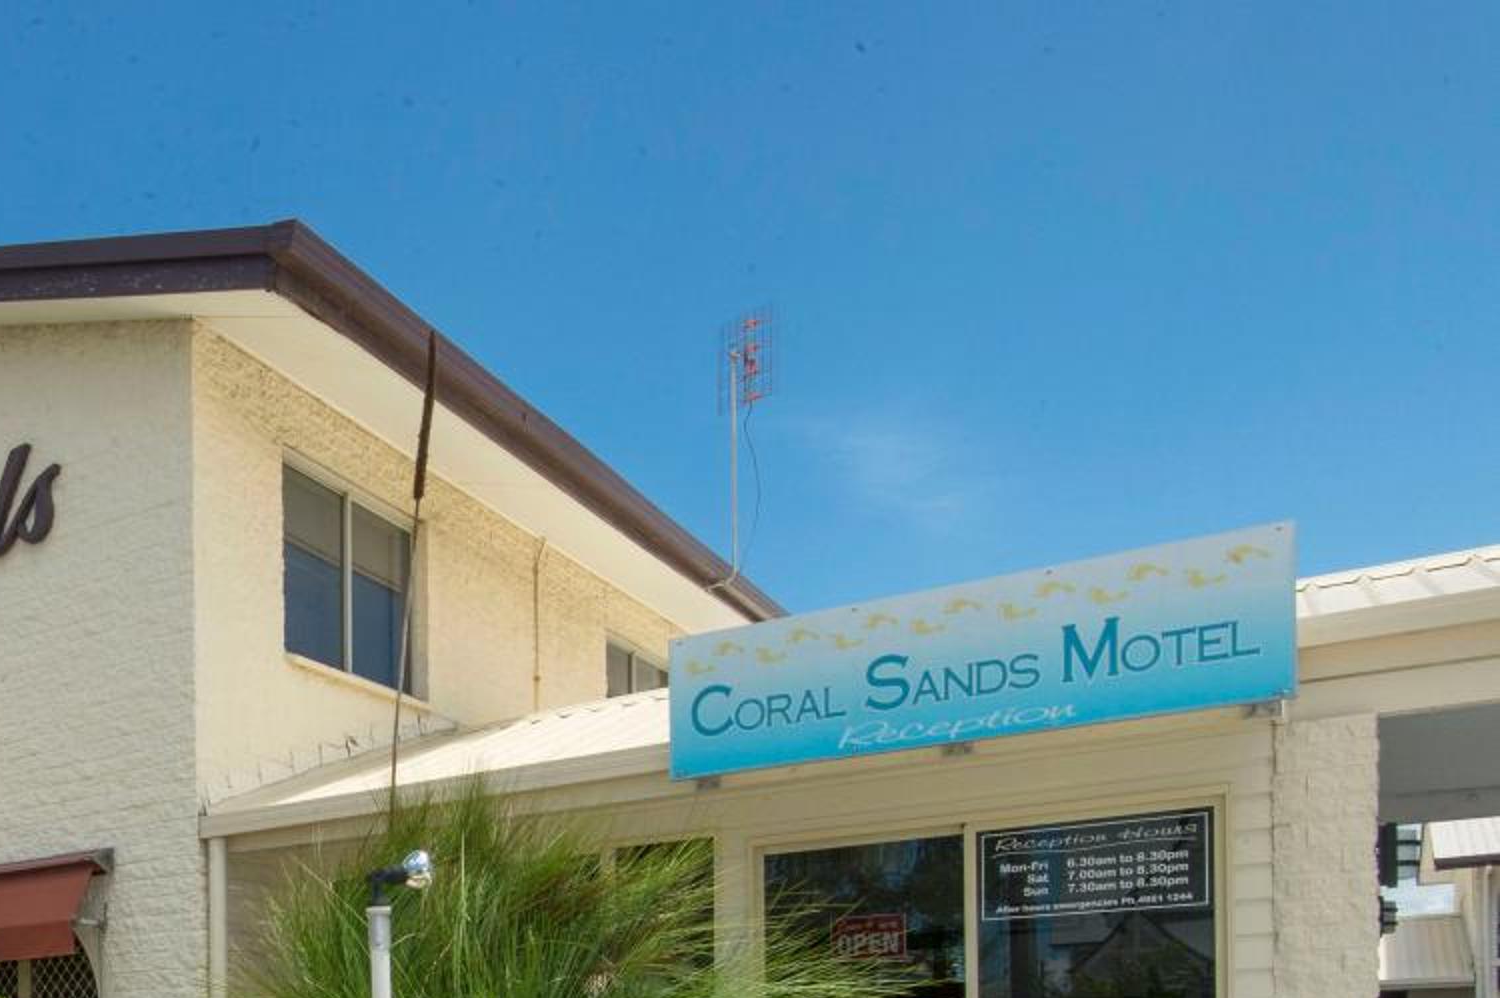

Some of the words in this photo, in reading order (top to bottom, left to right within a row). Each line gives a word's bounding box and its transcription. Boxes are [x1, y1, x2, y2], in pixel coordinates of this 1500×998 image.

[691, 684, 847, 737] CORAL
[865, 653, 1041, 711] SANDS
[1061, 616, 1261, 684] MOTEL
[837, 703, 1077, 749] Reception
[995, 834, 1106, 852] Reception
[1117, 823, 1198, 841] Hours
[1000, 861, 1049, 874] Mon-Fri
[1119, 853, 1133, 864] to
[1027, 873, 1049, 884] Sat
[1119, 865, 1133, 876] to
[1023, 887, 1049, 898] Sun
[1119, 879, 1133, 890] to
[837, 932, 899, 954] OPEN
